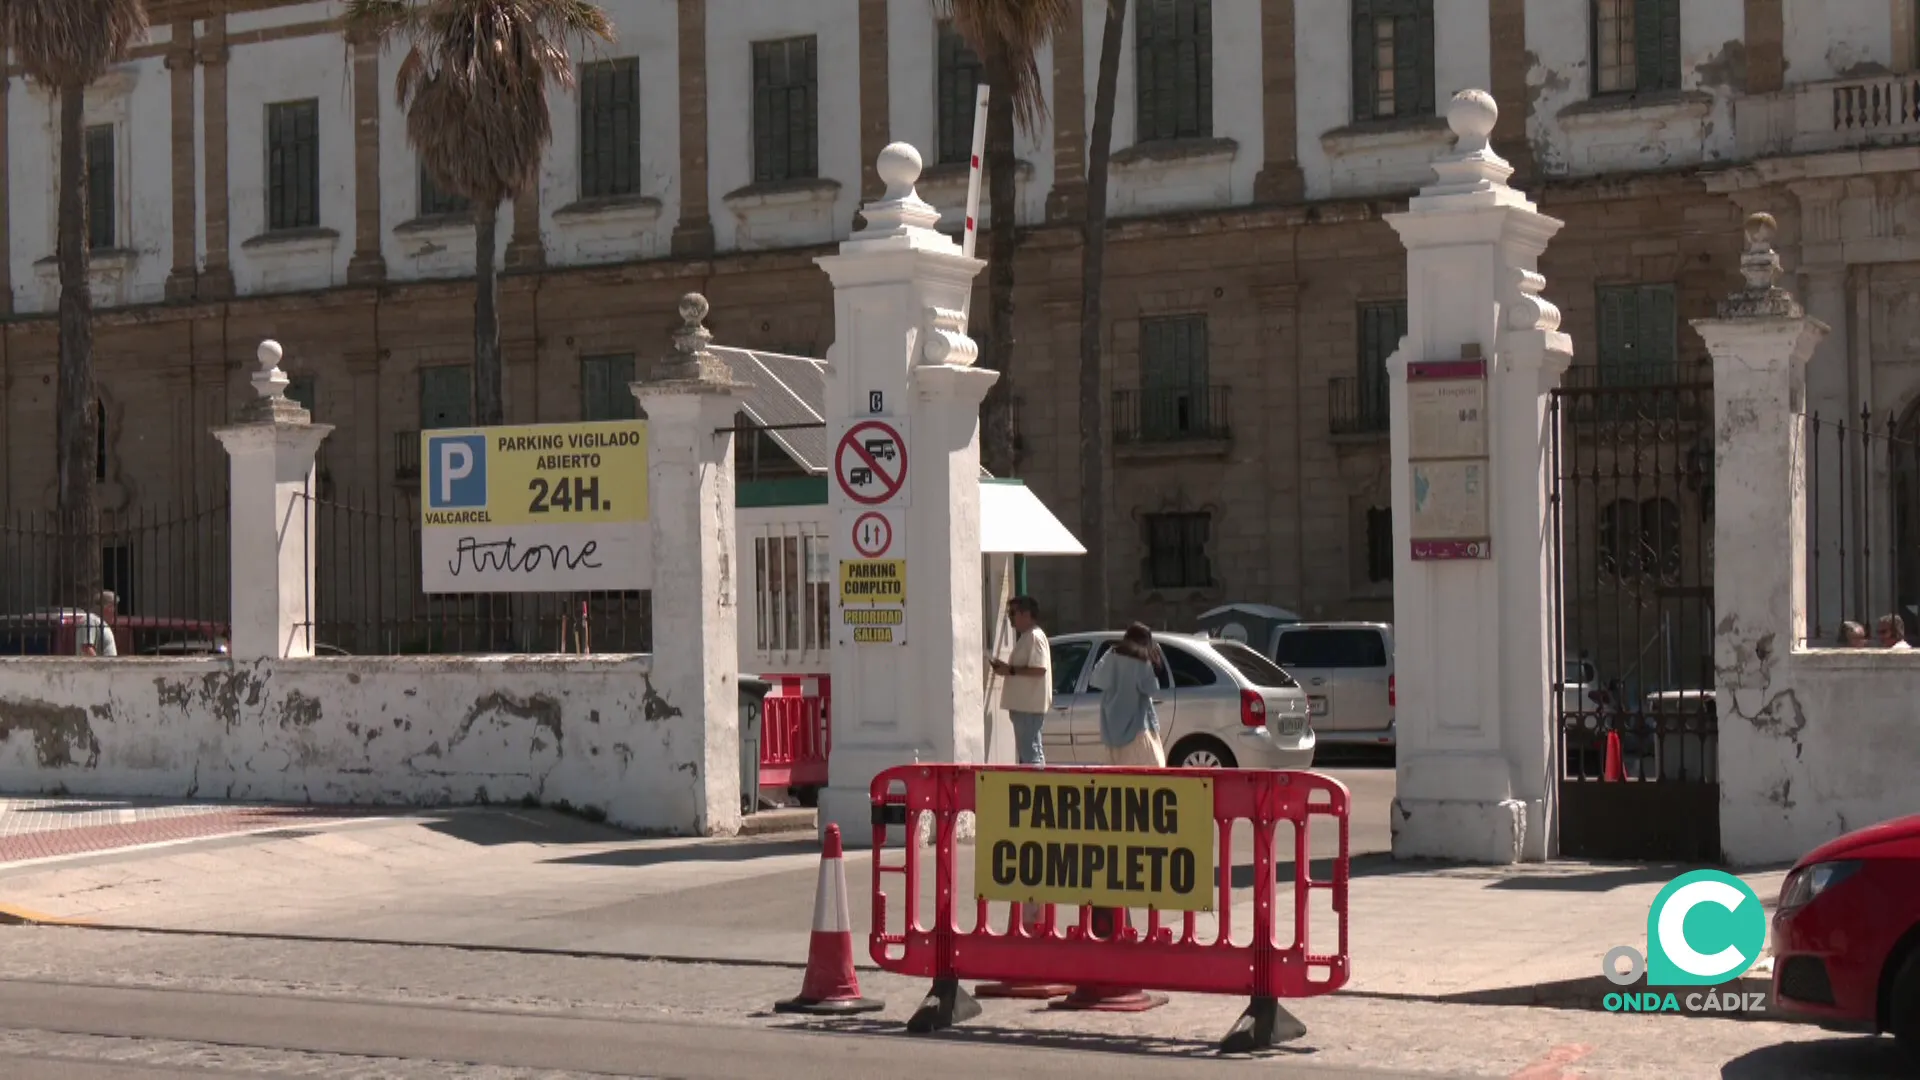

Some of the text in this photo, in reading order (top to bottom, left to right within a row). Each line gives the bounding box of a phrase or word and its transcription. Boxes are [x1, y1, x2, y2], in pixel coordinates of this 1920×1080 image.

[498, 431, 640, 452] PARKING VIGILADO
[536, 453, 601, 470] ABIERTO
[440, 441, 474, 504] P
[528, 476, 611, 514] 24H.
[425, 510, 492, 525] VALCARCEL
[849, 563, 896, 579] PARKING
[844, 580, 901, 595] COMPLETO
[843, 609, 903, 626] PRIORIDAD
[853, 627, 893, 643] SALIDA
[1008, 783, 1178, 835] PARKING
[991, 839, 1196, 895] COMPLETO
